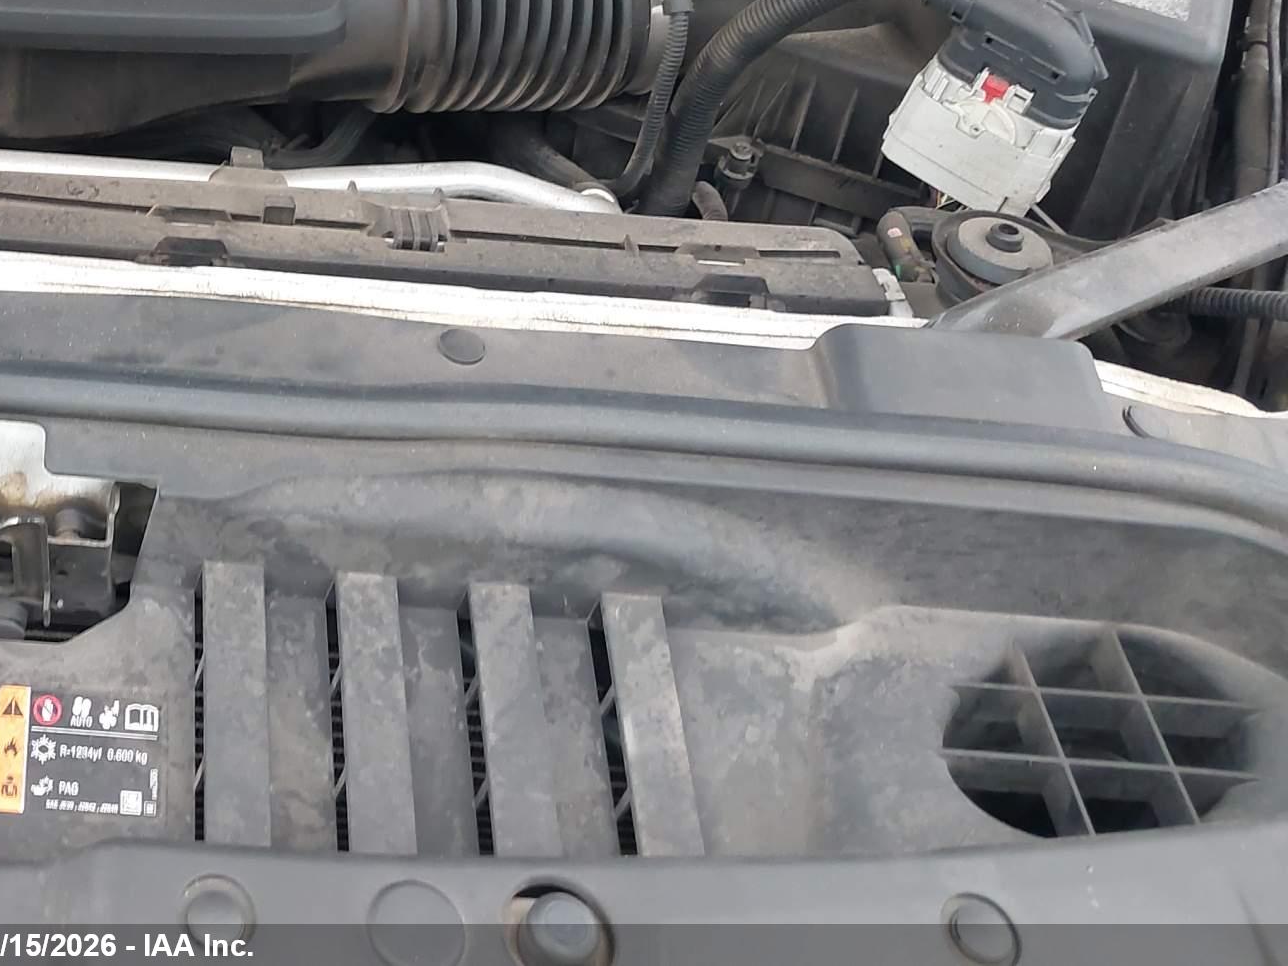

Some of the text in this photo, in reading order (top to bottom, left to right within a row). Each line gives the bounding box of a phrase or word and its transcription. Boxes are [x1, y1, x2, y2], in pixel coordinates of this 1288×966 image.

[70, 715, 93, 728] AUTO
[135, 749, 148, 766] kg
[58, 780, 79, 796] PAG
